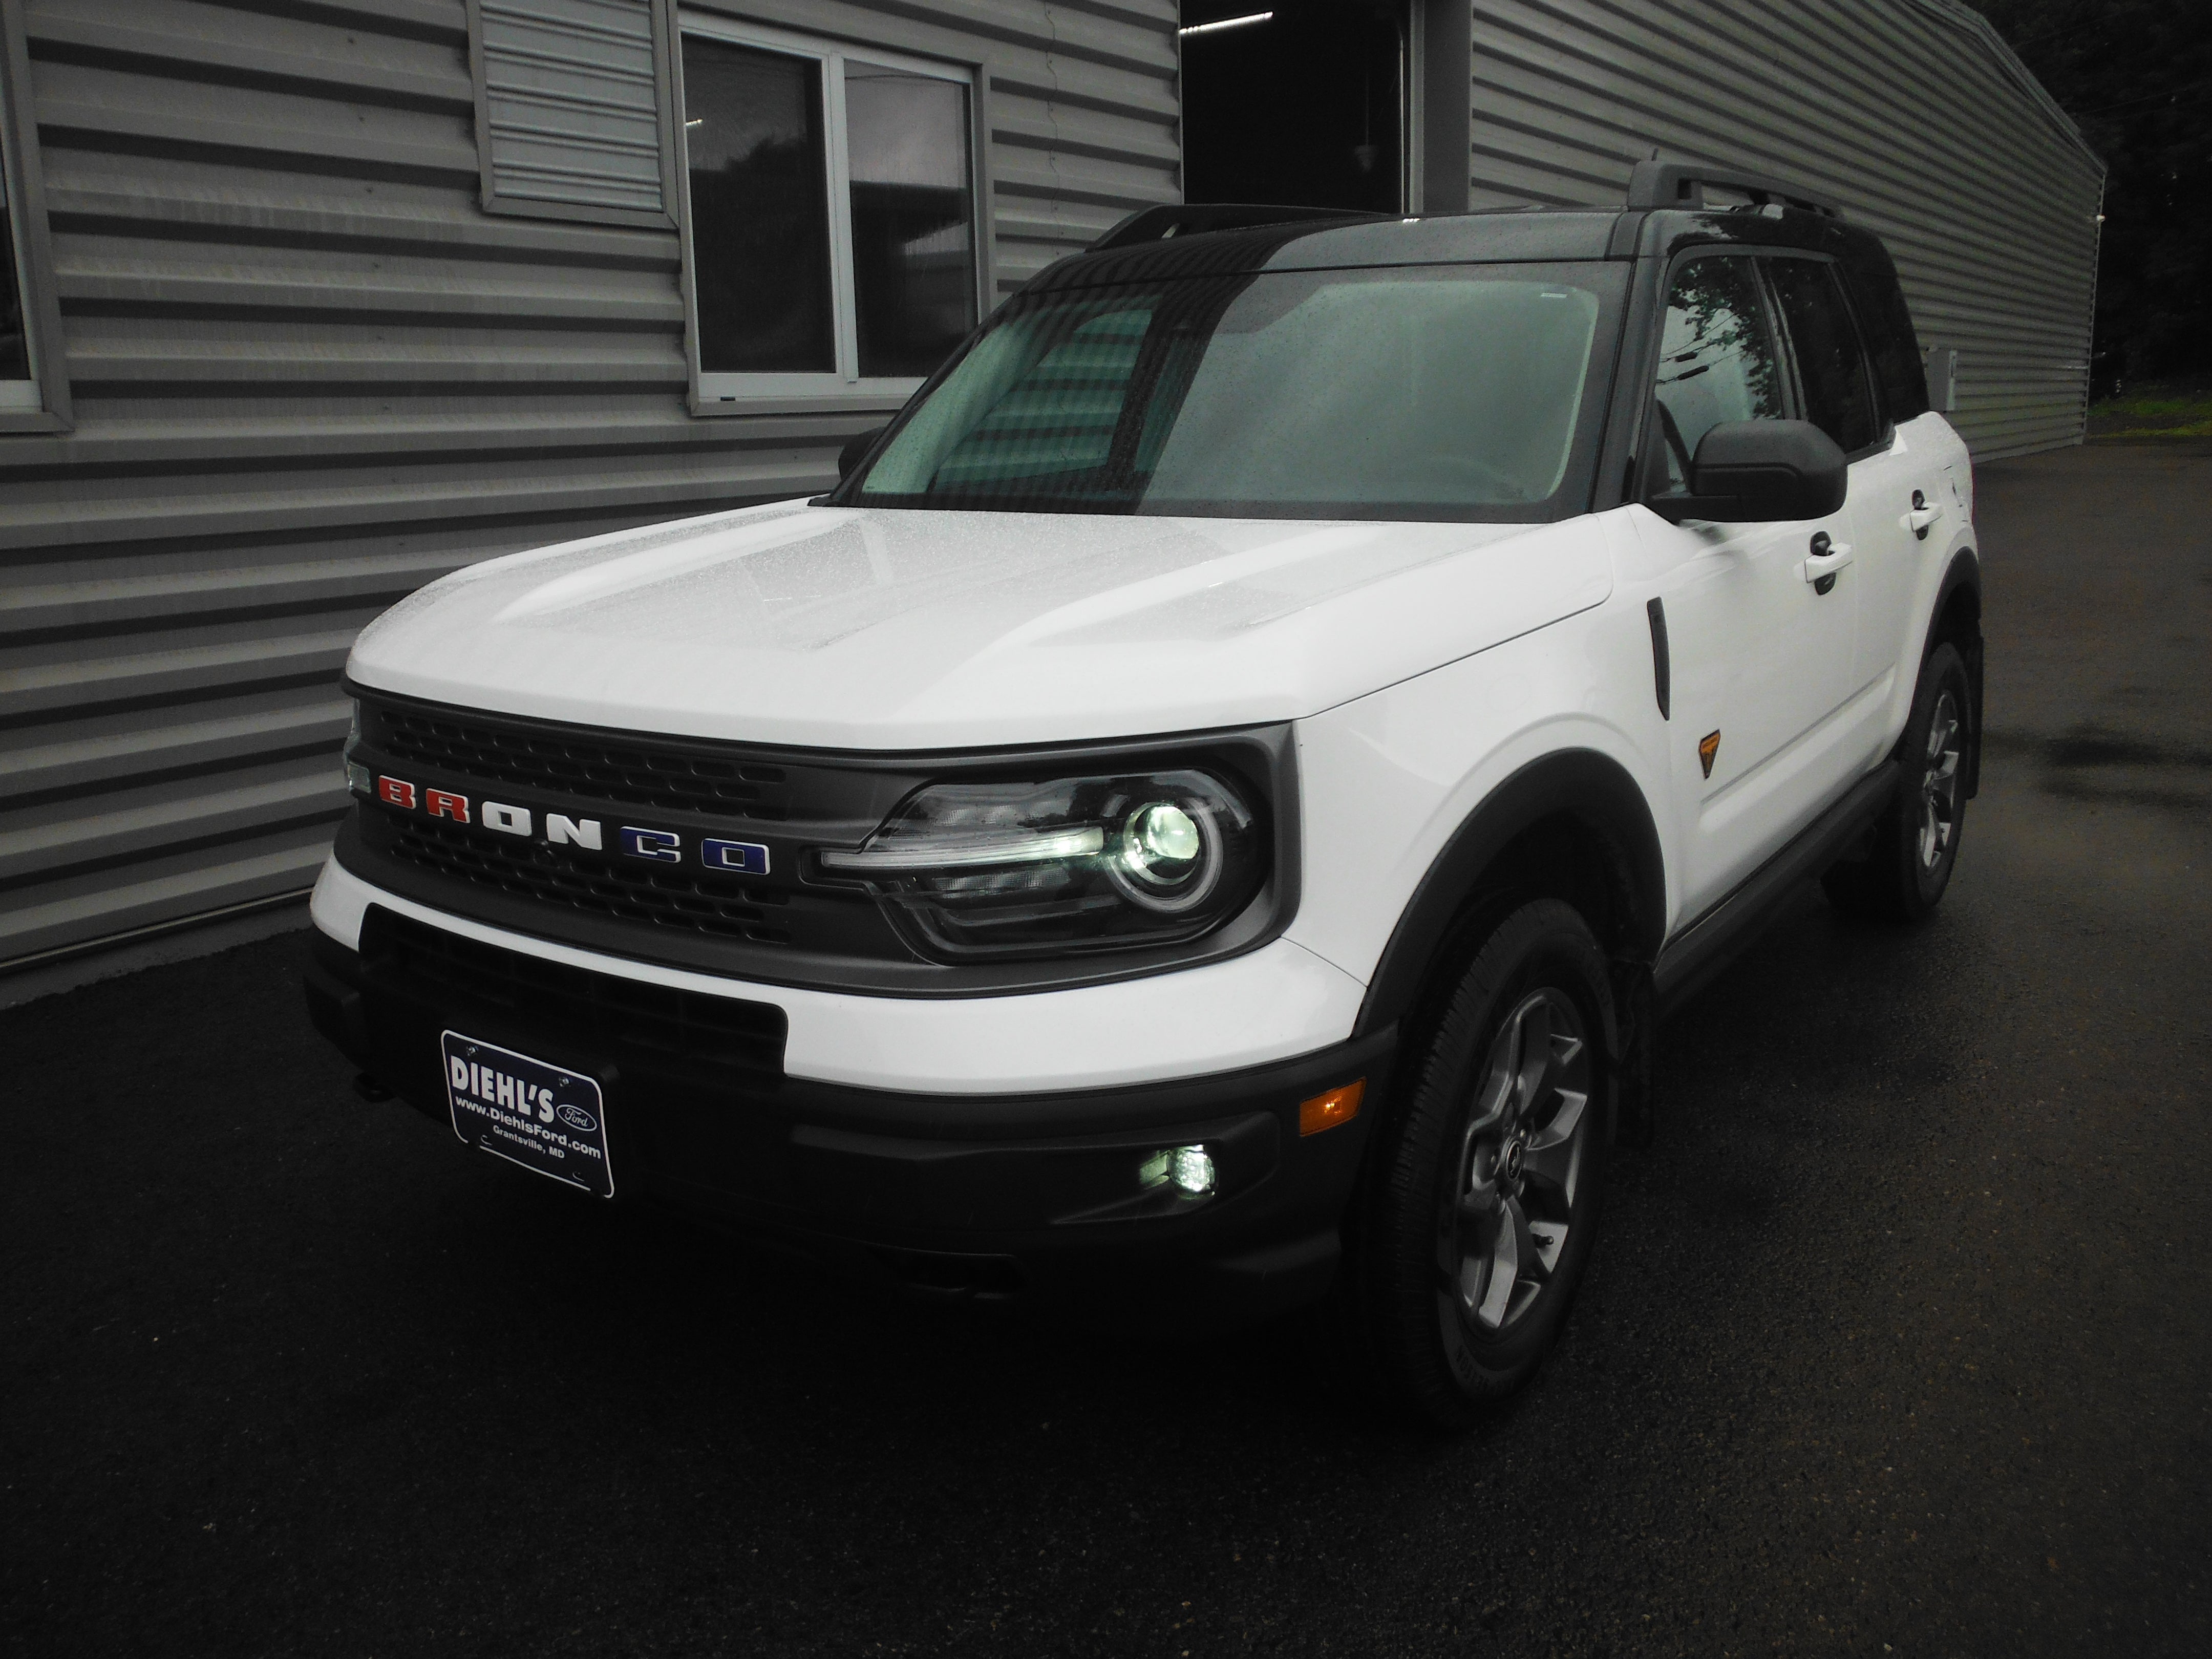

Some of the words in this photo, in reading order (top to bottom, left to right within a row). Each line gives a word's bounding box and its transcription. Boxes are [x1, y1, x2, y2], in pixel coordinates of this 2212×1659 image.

[378, 775, 771, 876] BRONCO
[451, 1055, 555, 1123] DIEHL'S
[564, 1107, 589, 1128] Ford
[455, 1096, 601, 1159] www.DiehlsFord.com
[493, 1124, 546, 1154] Grantsville,
[549, 1146, 565, 1159] MD
